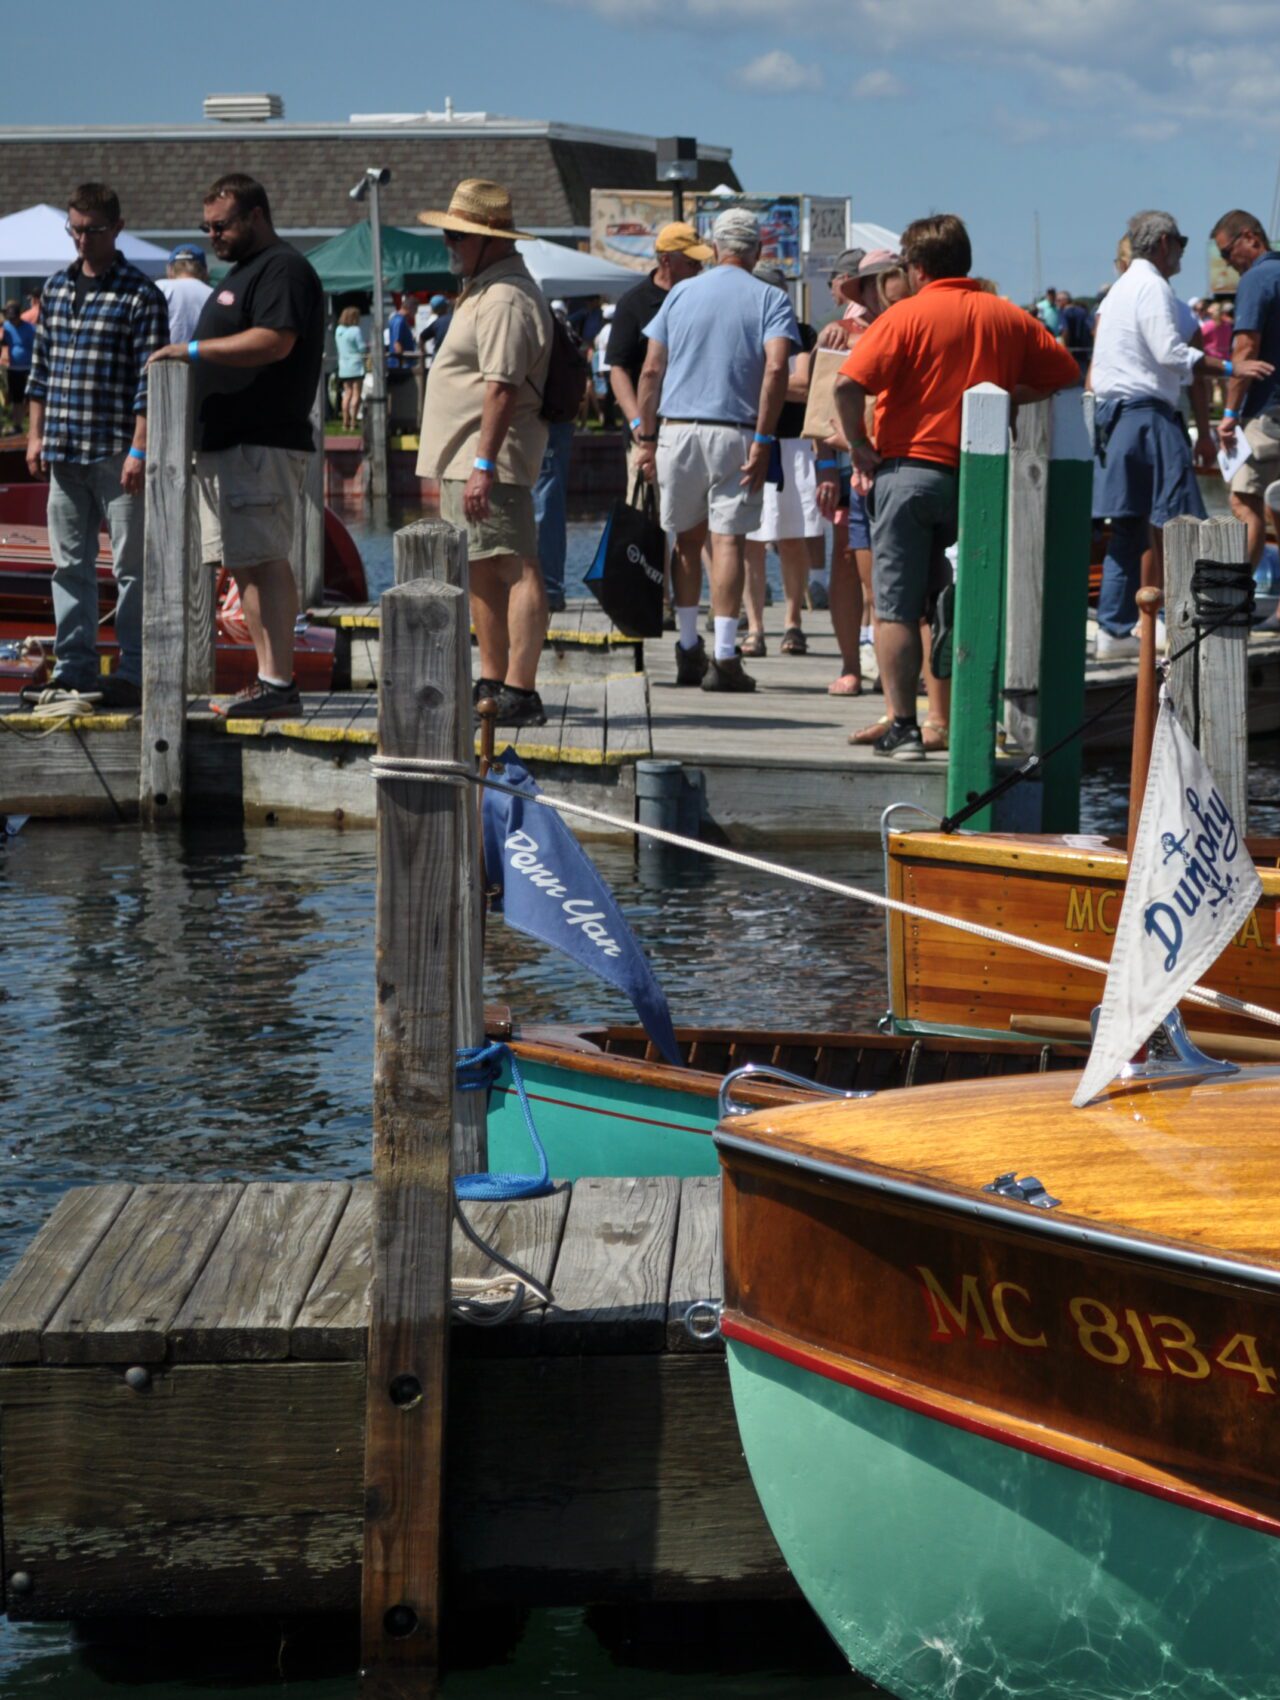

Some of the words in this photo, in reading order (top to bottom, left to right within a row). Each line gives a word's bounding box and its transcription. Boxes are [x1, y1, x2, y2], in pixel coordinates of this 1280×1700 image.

[505, 829, 567, 898] Penn
[562, 899, 622, 957] Yan
[1066, 888, 1116, 933] MC
[1145, 787, 1239, 973] Dunphy
[917, 1266, 1047, 1347] MC
[1069, 1296, 1278, 1395] 8134
